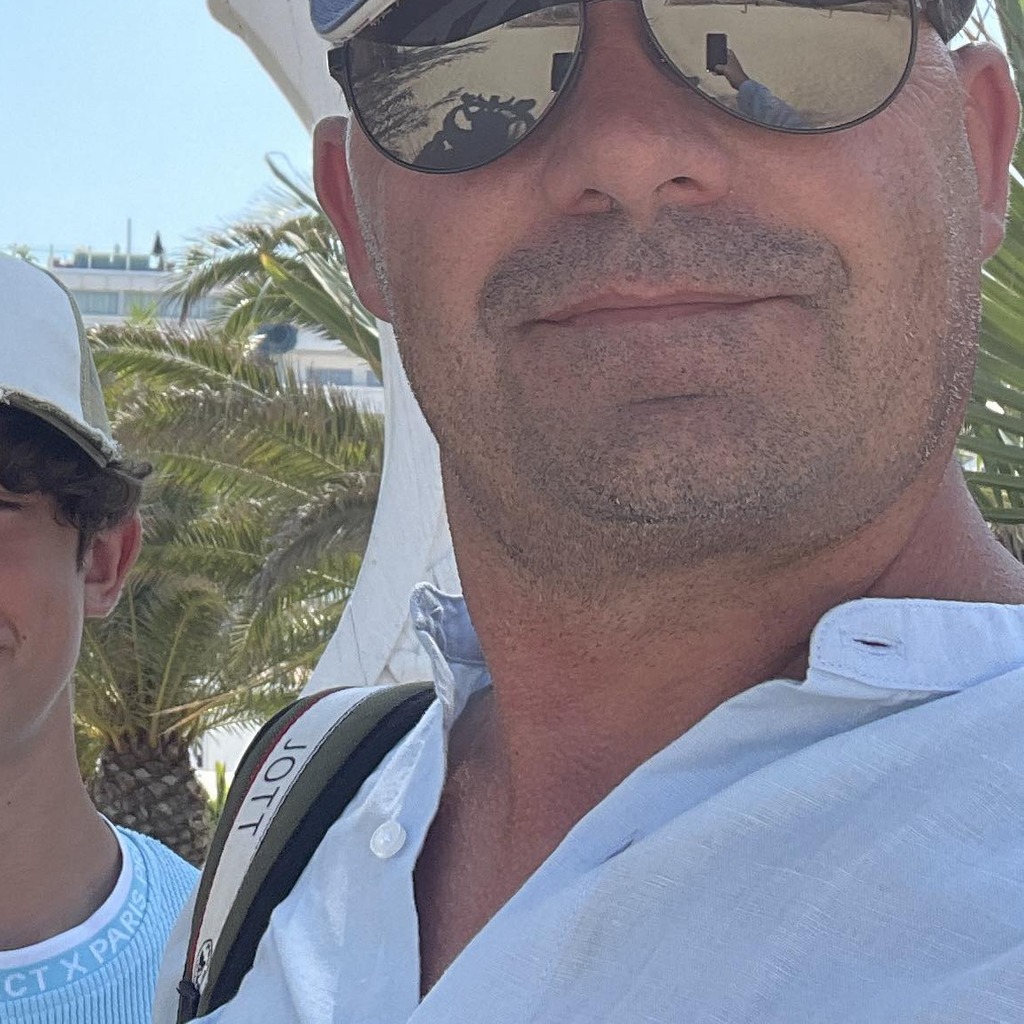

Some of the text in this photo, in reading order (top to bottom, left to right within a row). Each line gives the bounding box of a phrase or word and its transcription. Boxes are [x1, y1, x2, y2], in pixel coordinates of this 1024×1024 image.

[237, 738, 307, 836] JOTT
[60, 951, 88, 981] X
[89, 889, 147, 964] PARIS
